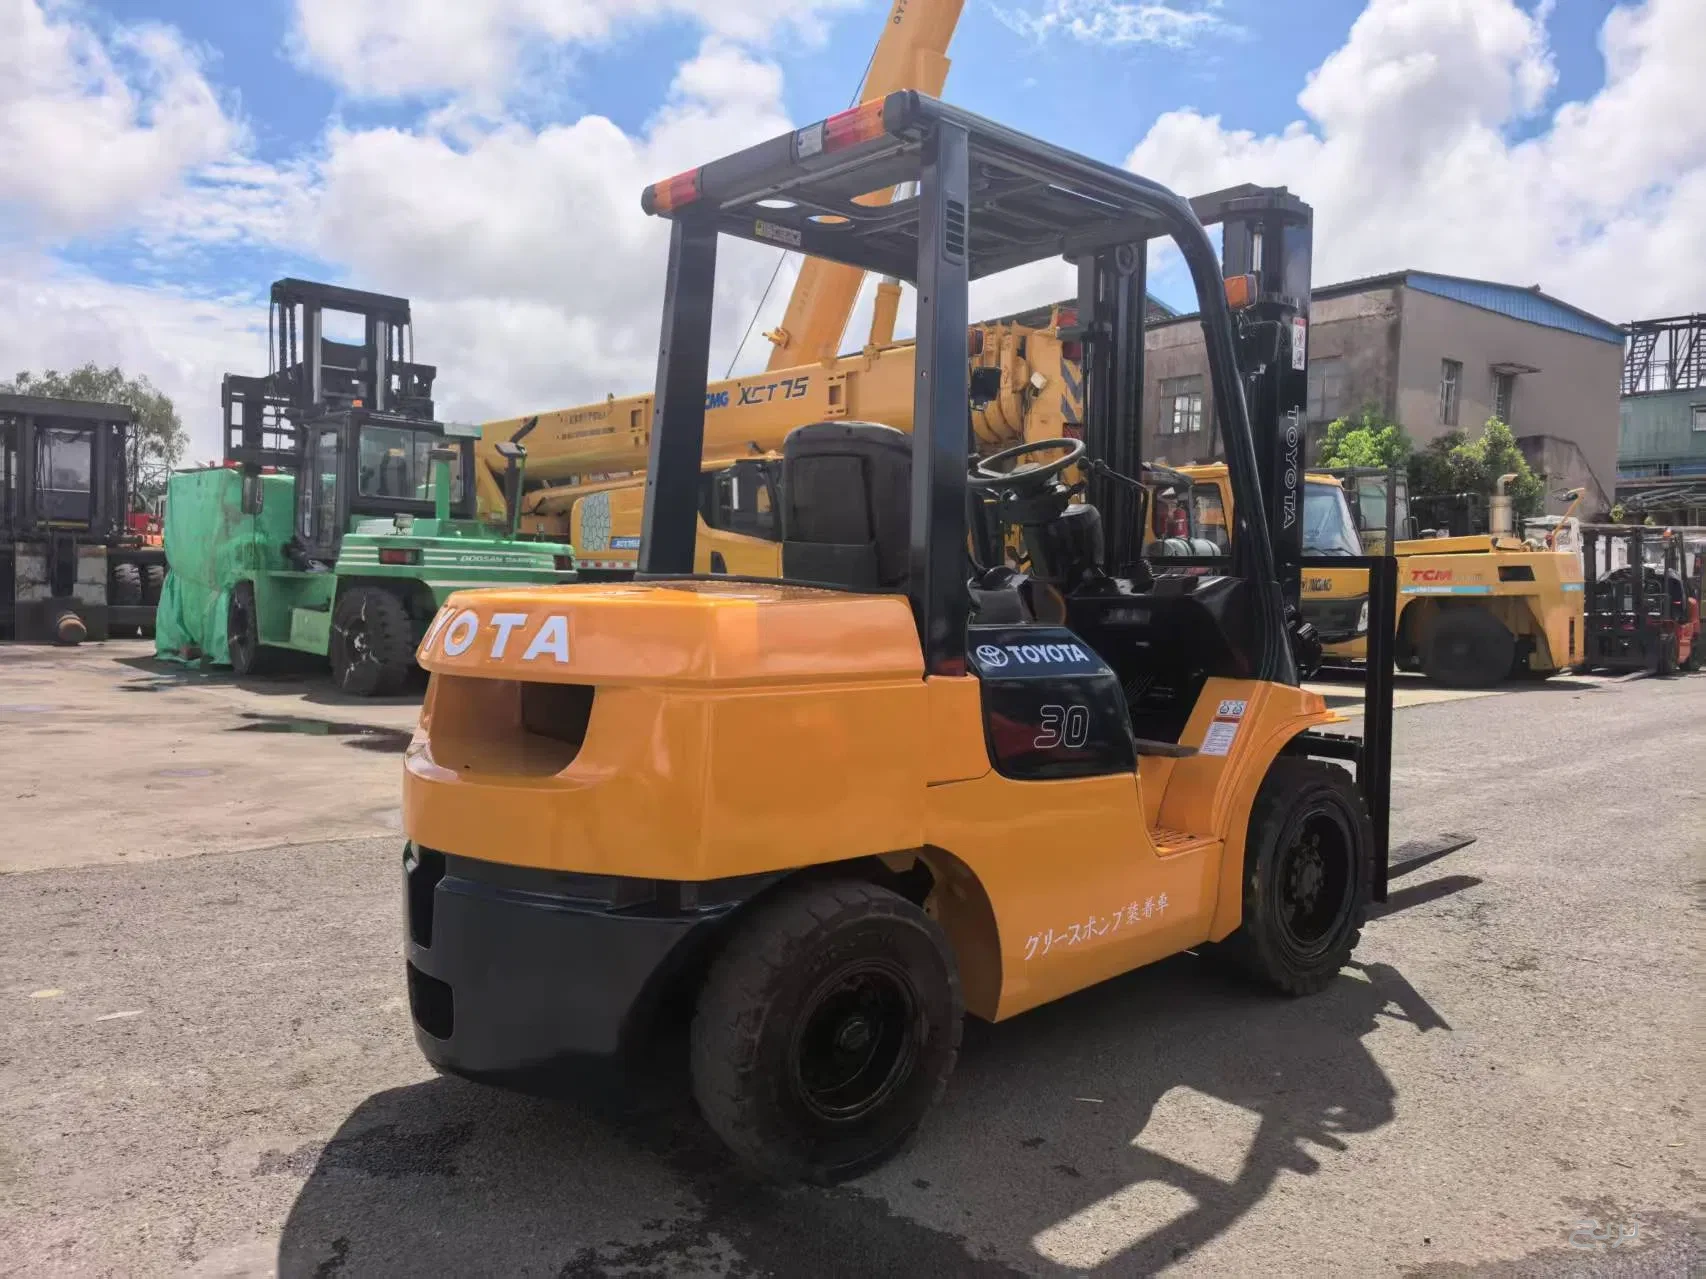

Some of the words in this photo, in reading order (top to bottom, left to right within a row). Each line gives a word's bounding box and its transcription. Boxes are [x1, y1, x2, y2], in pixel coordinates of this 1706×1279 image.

[1283, 405, 1299, 529] TOYOTA
[1410, 568, 1453, 582] TCM
[1005, 644, 1090, 664] TOYOTA
[1033, 704, 1090, 749] 30
